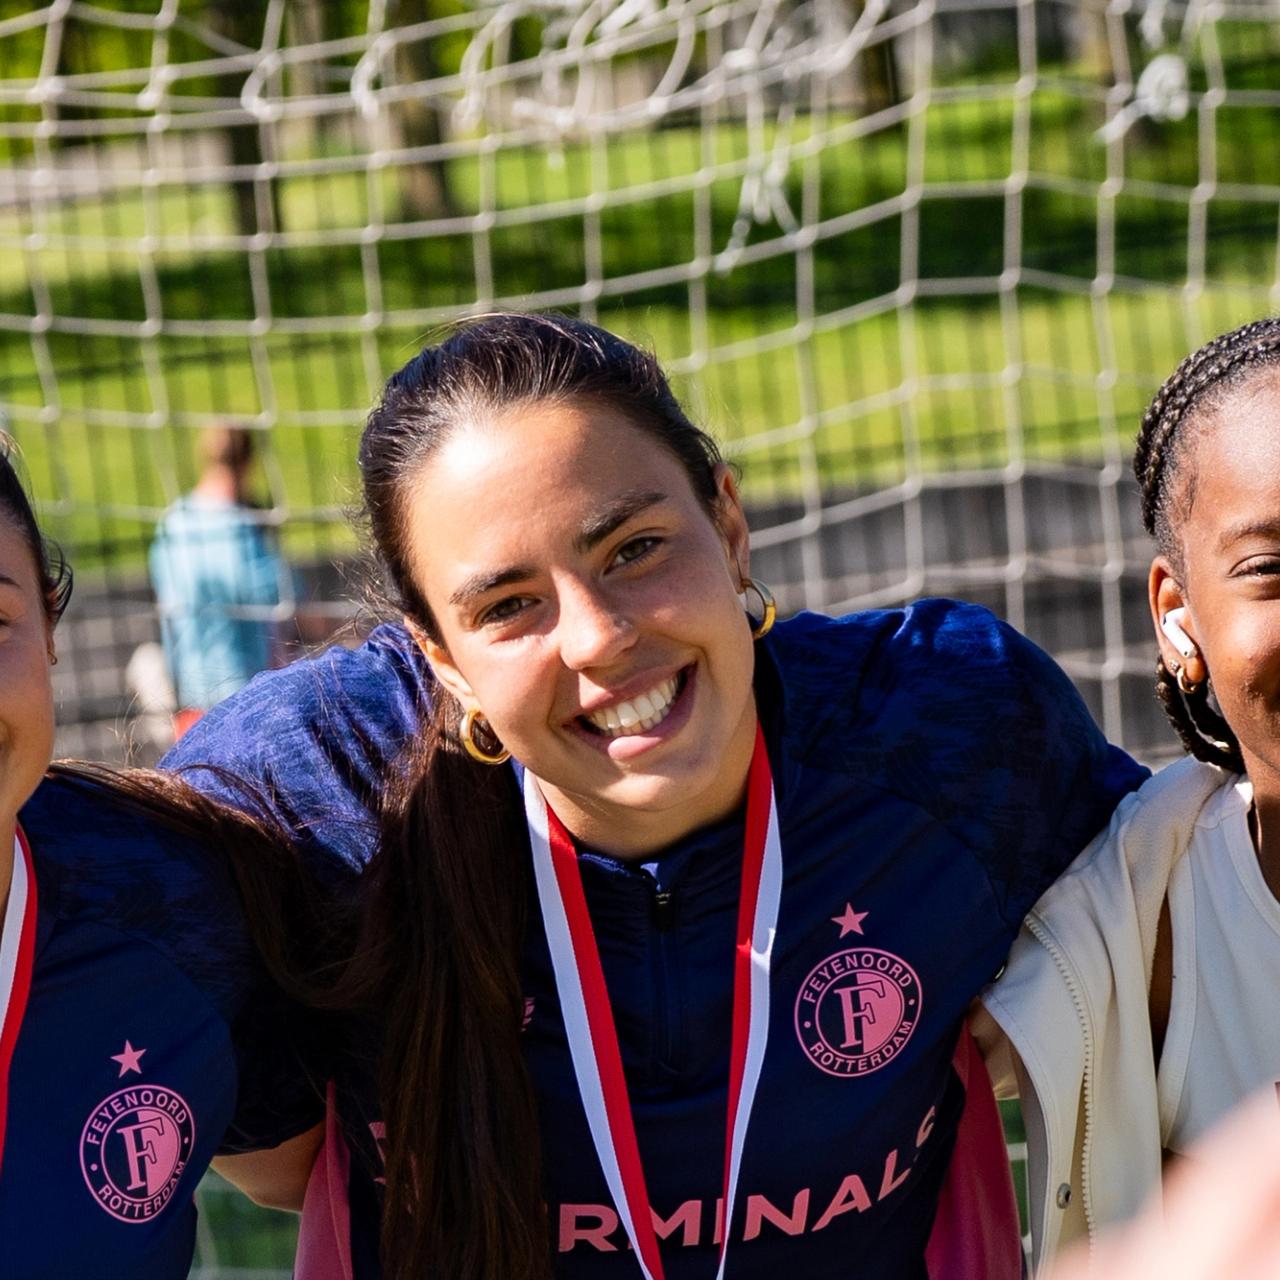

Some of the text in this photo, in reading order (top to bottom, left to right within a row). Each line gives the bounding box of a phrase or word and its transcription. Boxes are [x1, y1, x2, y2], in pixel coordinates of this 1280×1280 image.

[803, 953, 912, 1004] FEYENOORD
[833, 980, 885, 1048] F
[810, 1021, 913, 1073] ROTTERDAM
[87, 1090, 187, 1145] FEYENOORD
[116, 1117, 165, 1191] F
[98, 1161, 186, 1218] ROTTERDAM
